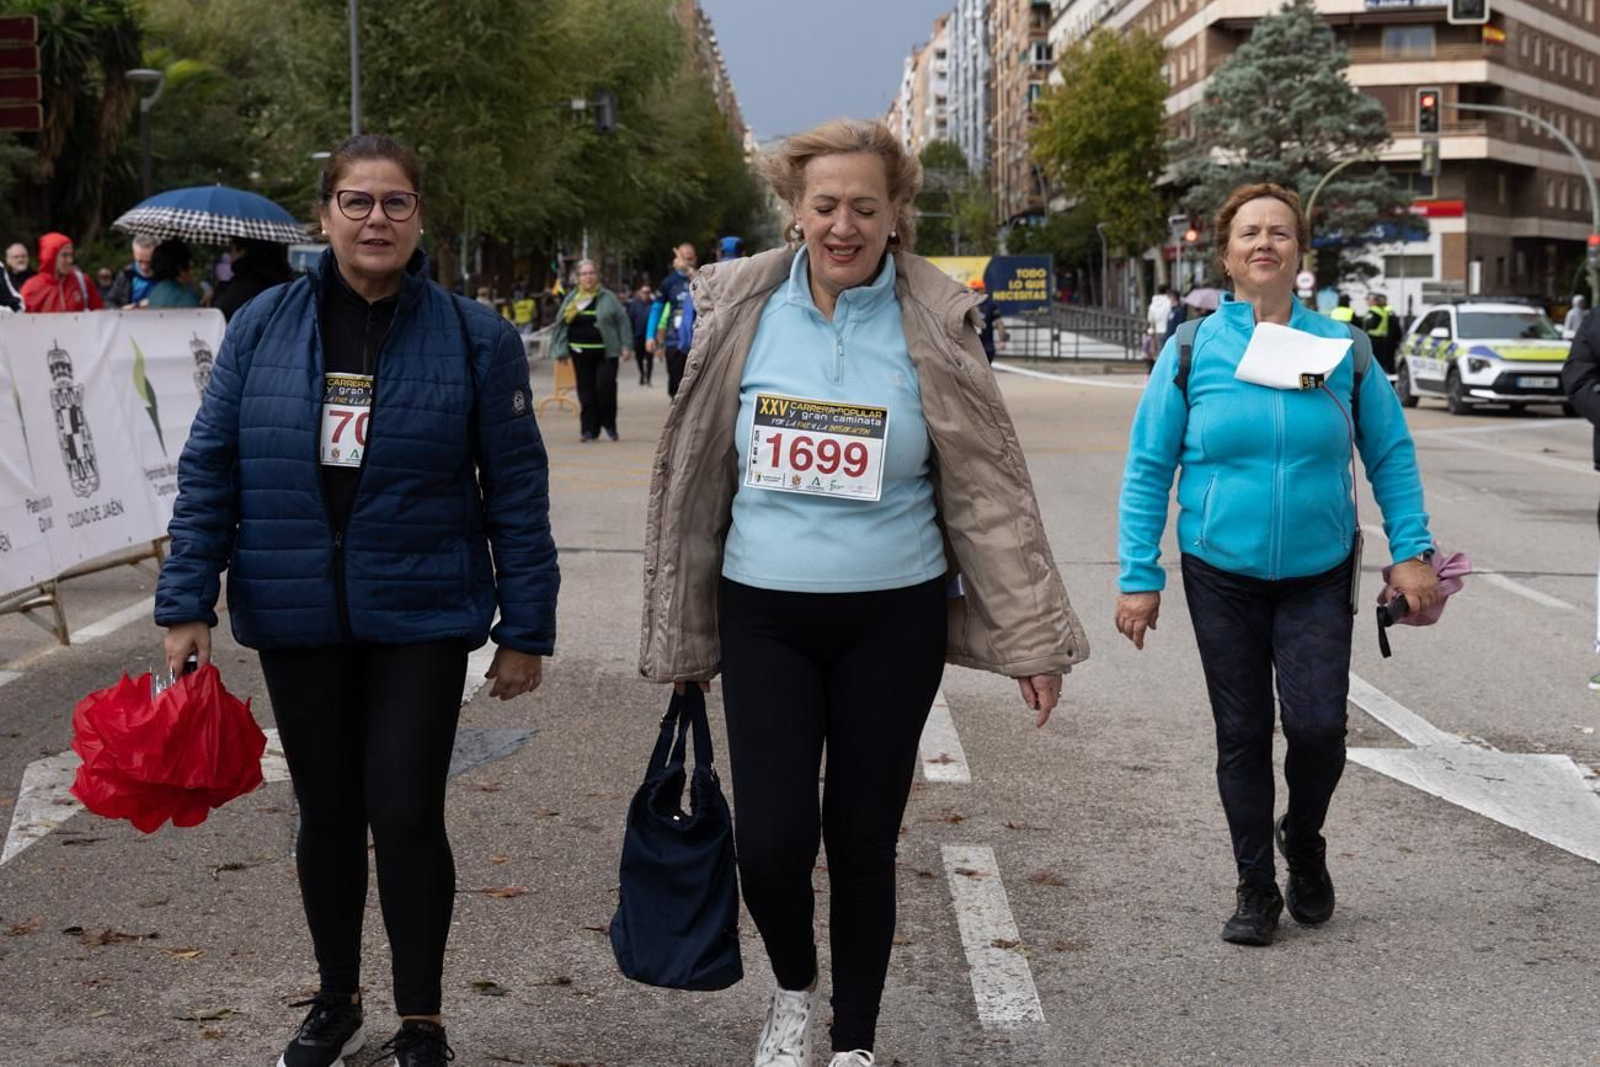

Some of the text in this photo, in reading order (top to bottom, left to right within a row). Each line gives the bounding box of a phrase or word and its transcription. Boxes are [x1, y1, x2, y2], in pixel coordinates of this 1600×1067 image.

[1016, 268, 1046, 278] TODO
[1008, 280, 1046, 289] LO QUE
[993, 291, 1047, 300] NECESITAS
[327, 379, 371, 388] CARRERA
[760, 398, 789, 417] XXV
[790, 401, 882, 419] CARRERA POPULAR
[789, 410, 882, 427] y gran caminata
[766, 433, 868, 478] 1699
